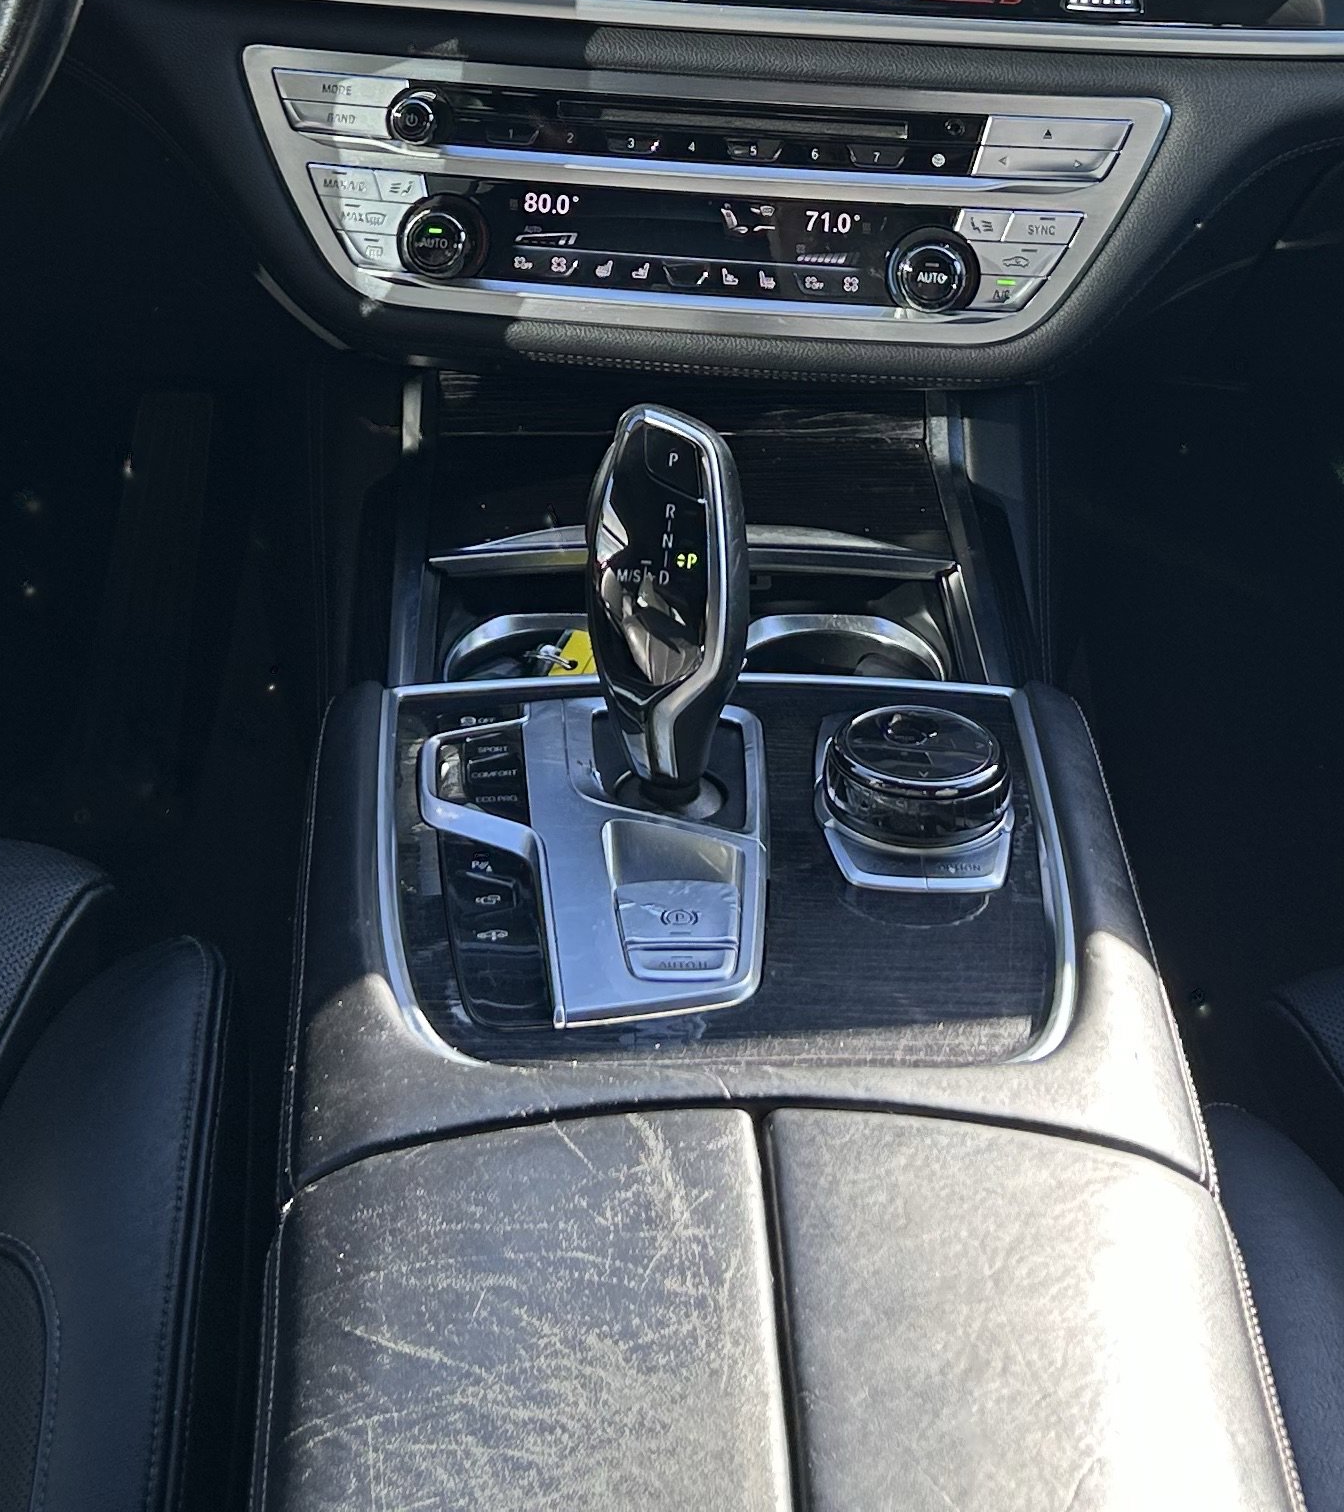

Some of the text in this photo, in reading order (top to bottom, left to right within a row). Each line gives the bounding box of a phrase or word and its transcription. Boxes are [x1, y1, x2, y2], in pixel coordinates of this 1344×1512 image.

[322, 83, 352, 96] MODE
[508, 128, 515, 140] 1
[566, 132, 575, 144] 2
[627, 138, 636, 150] 3
[687, 141, 696, 153] 4
[749, 145, 757, 157] 5
[811, 148, 820, 161] 6
[872, 151, 882, 164] 7
[1028, 226, 1056, 236] SYNC
[422, 237, 448, 249] AUTO
[917, 272, 948, 285] AUTO
[669, 452, 679, 467] P
[665, 503, 676, 519] R
[662, 533, 674, 549] N
[686, 553, 698, 570] P
[659, 570, 670, 585] D
[478, 745, 508, 754] SPORT
[471, 768, 517, 779] COMFORT
